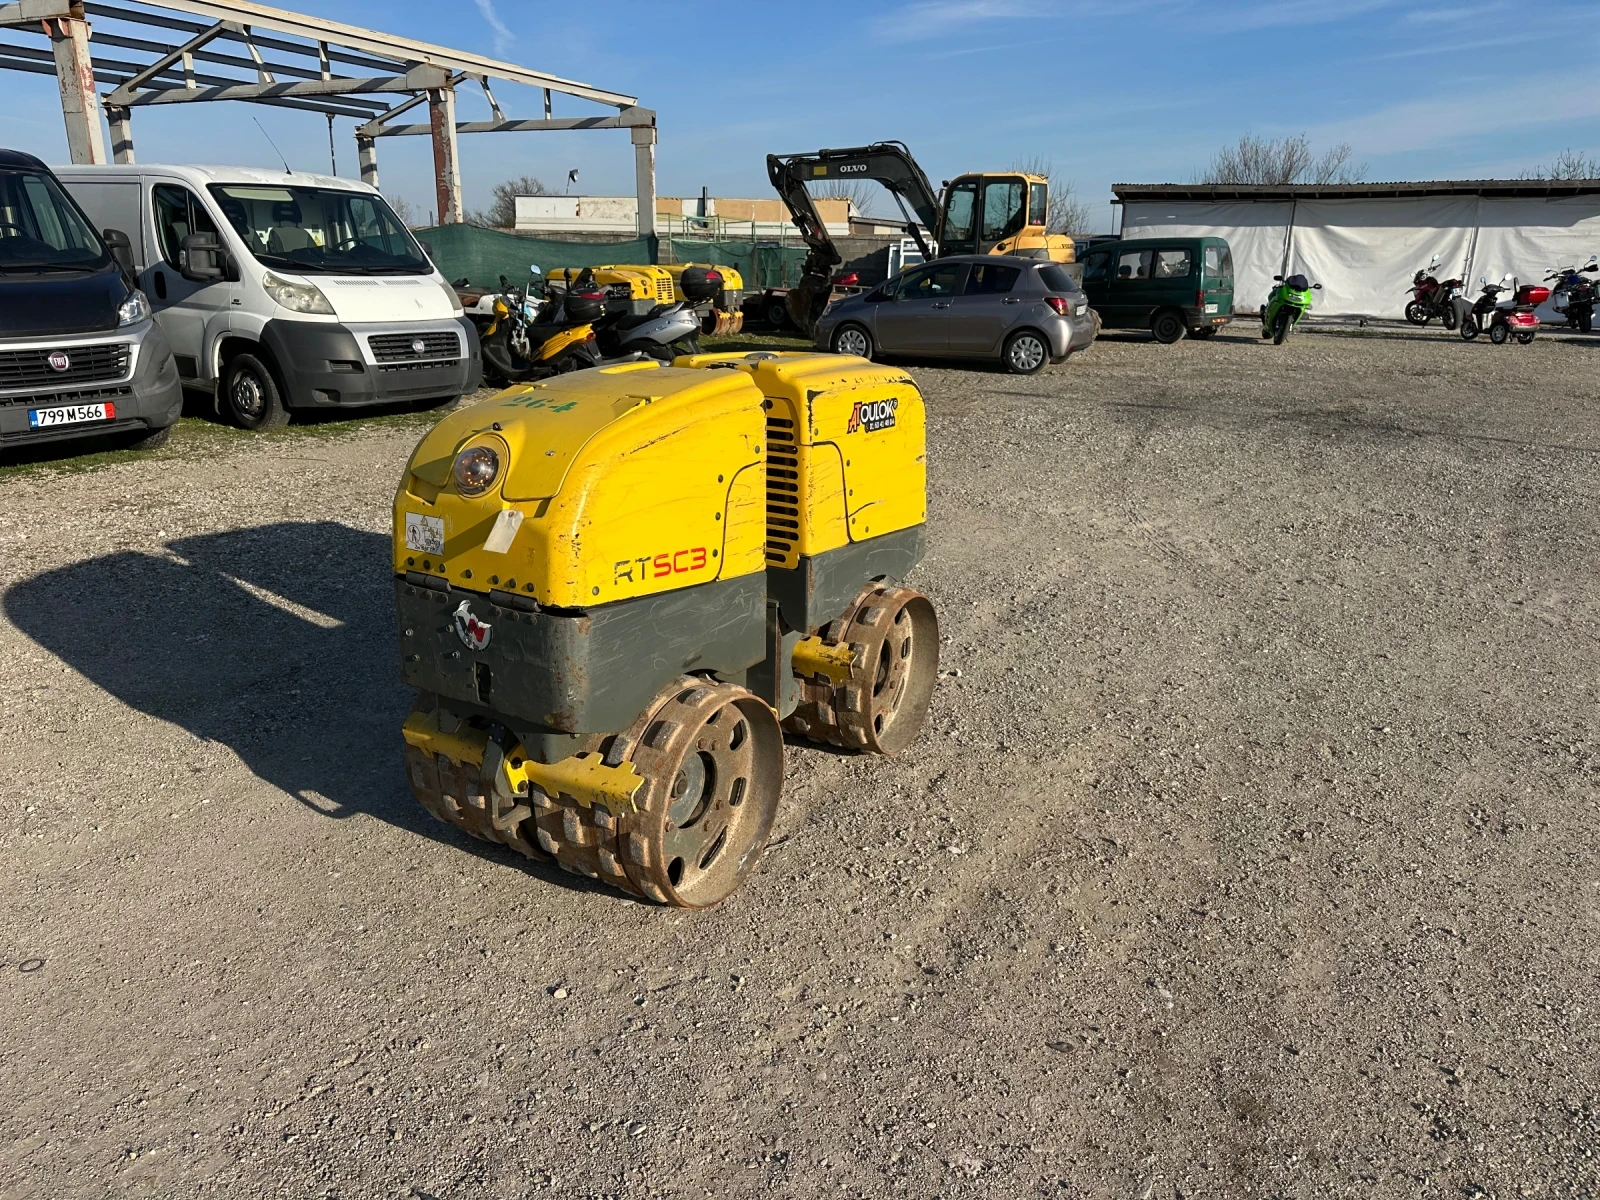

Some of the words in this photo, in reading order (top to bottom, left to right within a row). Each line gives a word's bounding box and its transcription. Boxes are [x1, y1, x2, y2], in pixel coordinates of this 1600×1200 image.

[53, 357, 66, 367] FIAT
[39, 409, 64, 424] 799
[67, 408, 76, 421] M
[78, 406, 102, 420] 566
[847, 398, 895, 433] ATOULOK
